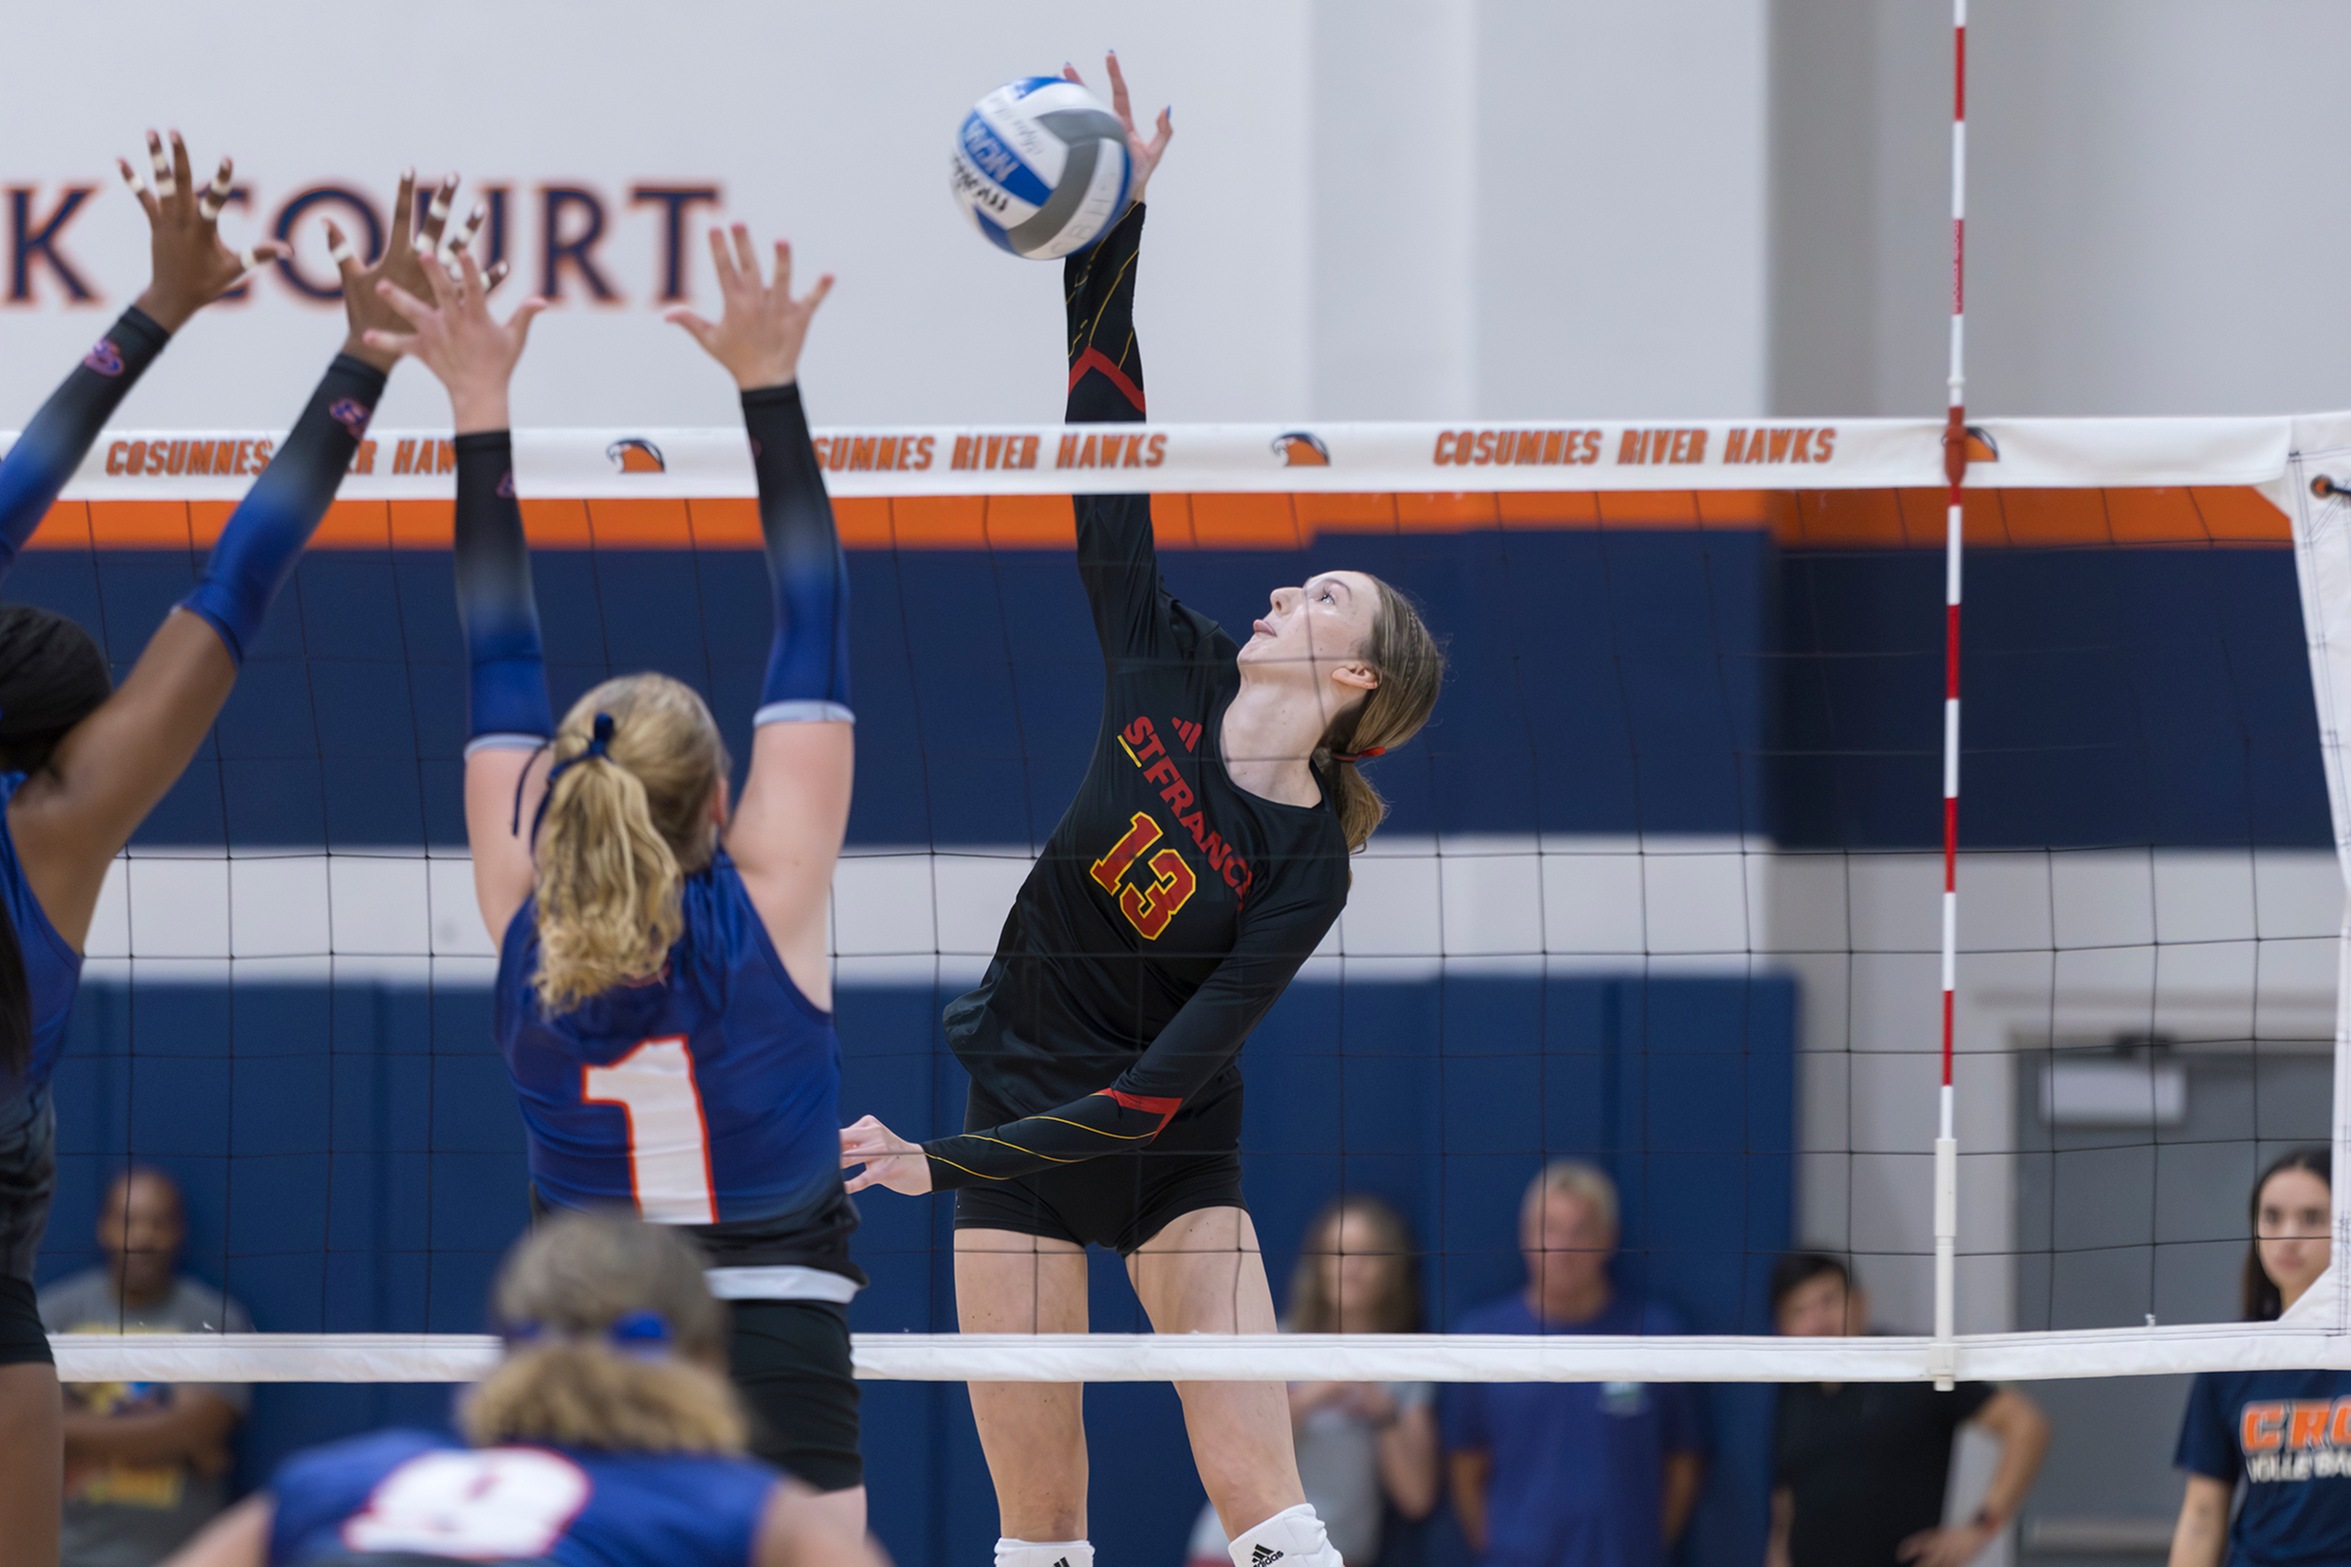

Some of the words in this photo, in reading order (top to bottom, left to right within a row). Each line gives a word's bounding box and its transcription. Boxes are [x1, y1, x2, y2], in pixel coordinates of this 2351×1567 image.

[105, 439, 272, 476] COSUMNES
[392, 439, 456, 475] HAW
[811, 436, 935, 472] SUMNES
[950, 434, 1040, 470] RIVER
[1056, 433, 1166, 468] HAWKS
[1433, 430, 1602, 466] COSUMNES
[1617, 429, 1708, 464] RIVER
[1723, 428, 1836, 463] HAWKS
[1089, 811, 1197, 941] 13
[581, 1033, 720, 1225] 1
